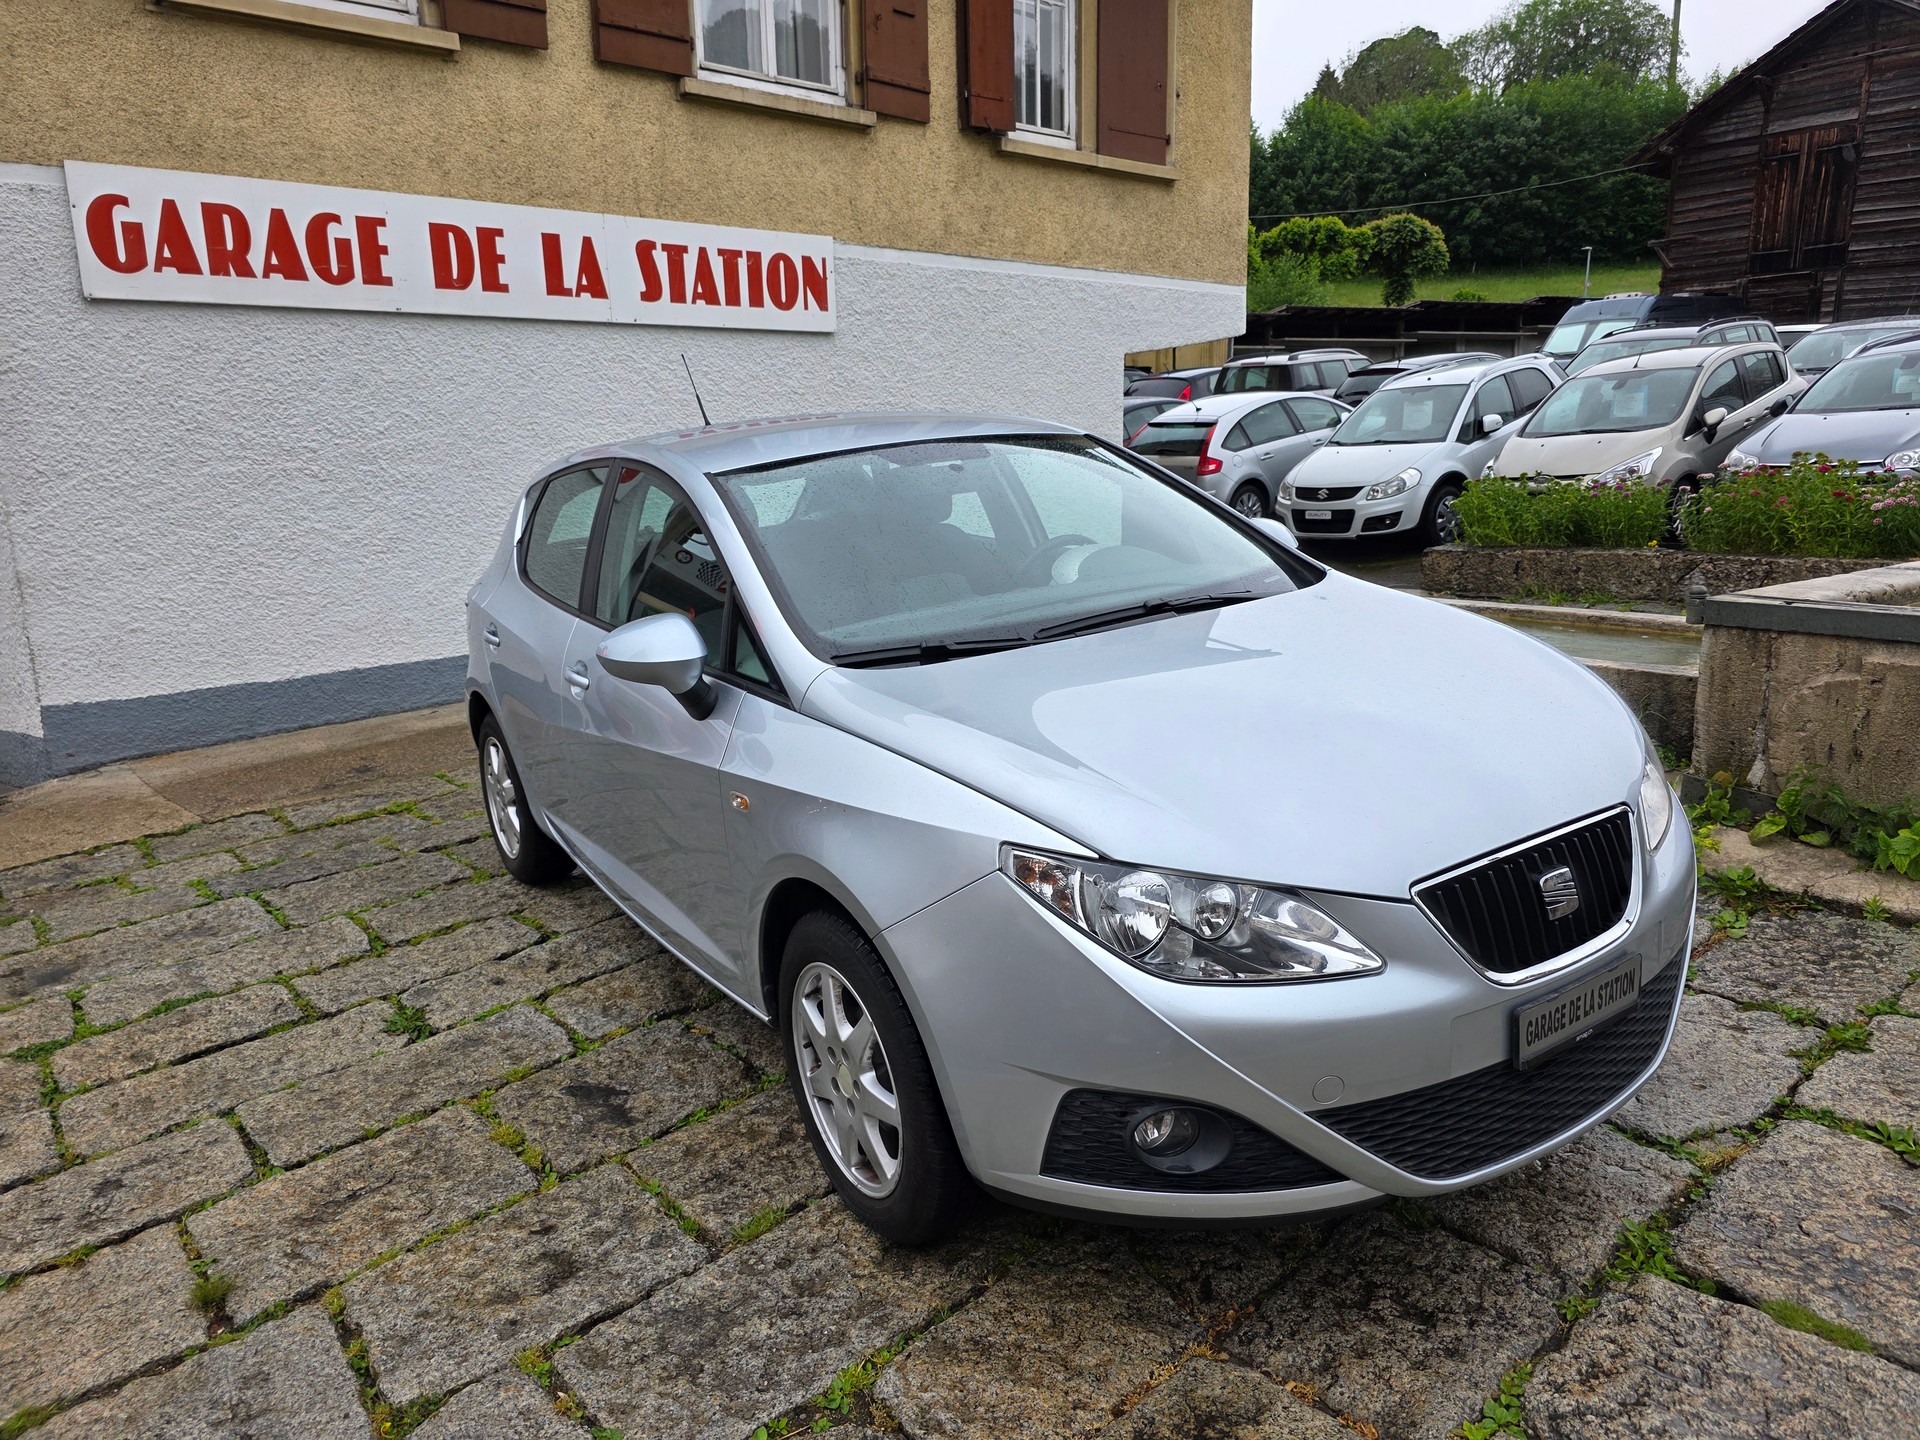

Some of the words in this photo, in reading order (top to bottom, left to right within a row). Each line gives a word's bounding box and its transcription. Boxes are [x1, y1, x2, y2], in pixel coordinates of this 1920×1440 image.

[86, 193, 393, 287] GARAGE
[428, 222, 510, 293] DE
[541, 232, 609, 299] LA
[635, 239, 829, 312] STATION
[1526, 1003, 1566, 1047] GARAGE
[1569, 996, 1581, 1026] DE
[1583, 989, 1595, 1018] LA
[1597, 968, 1635, 1011] STATION
